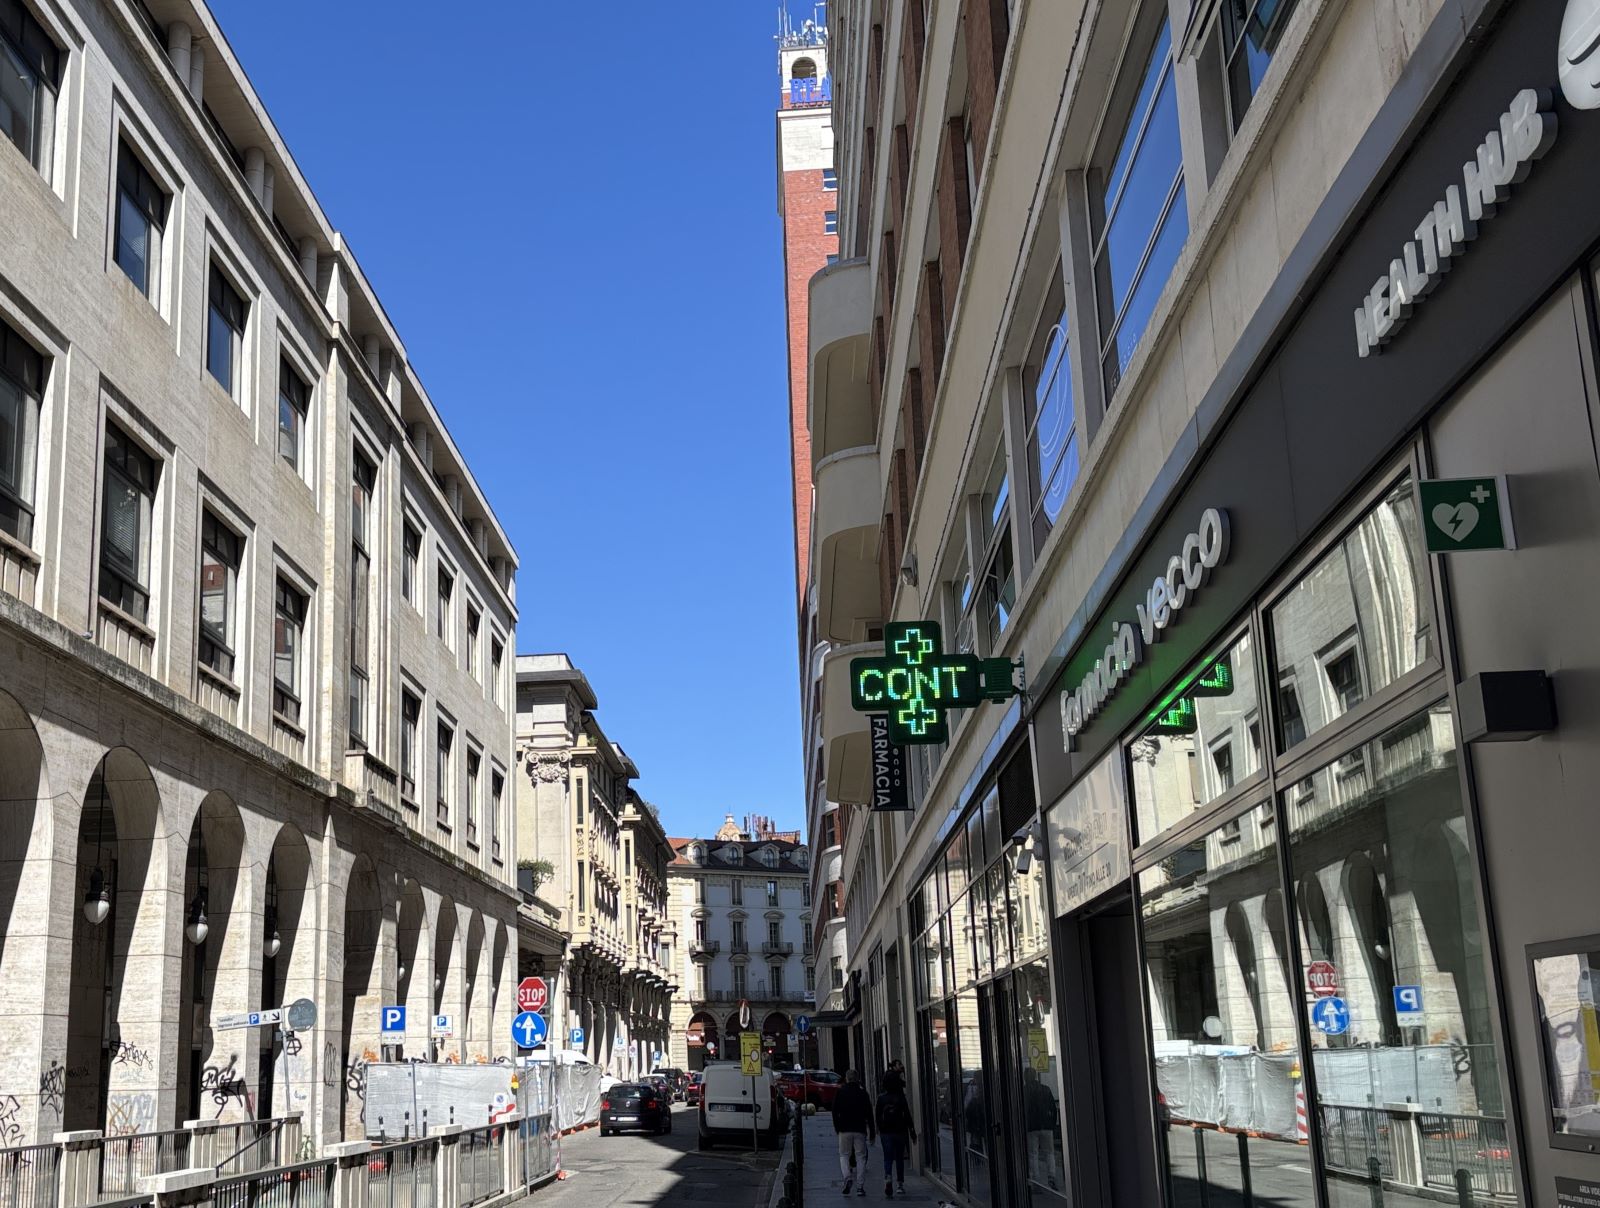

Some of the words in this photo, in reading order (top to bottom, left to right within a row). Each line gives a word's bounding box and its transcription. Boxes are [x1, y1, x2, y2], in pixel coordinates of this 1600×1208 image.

[1354, 185, 1464, 357] HEALTH
[1463, 89, 1543, 220] HUB
[1060, 622, 1136, 753] farmacia
[1136, 508, 1222, 645] vecco
[858, 666, 967, 701] CONT
[873, 718, 891, 807] FARMACIA
[892, 747, 901, 787] ecco
[519, 988, 545, 1002] STOP
[250, 1015, 258, 1024] P
[386, 1009, 401, 1029] P
[573, 1030, 582, 1042] P
